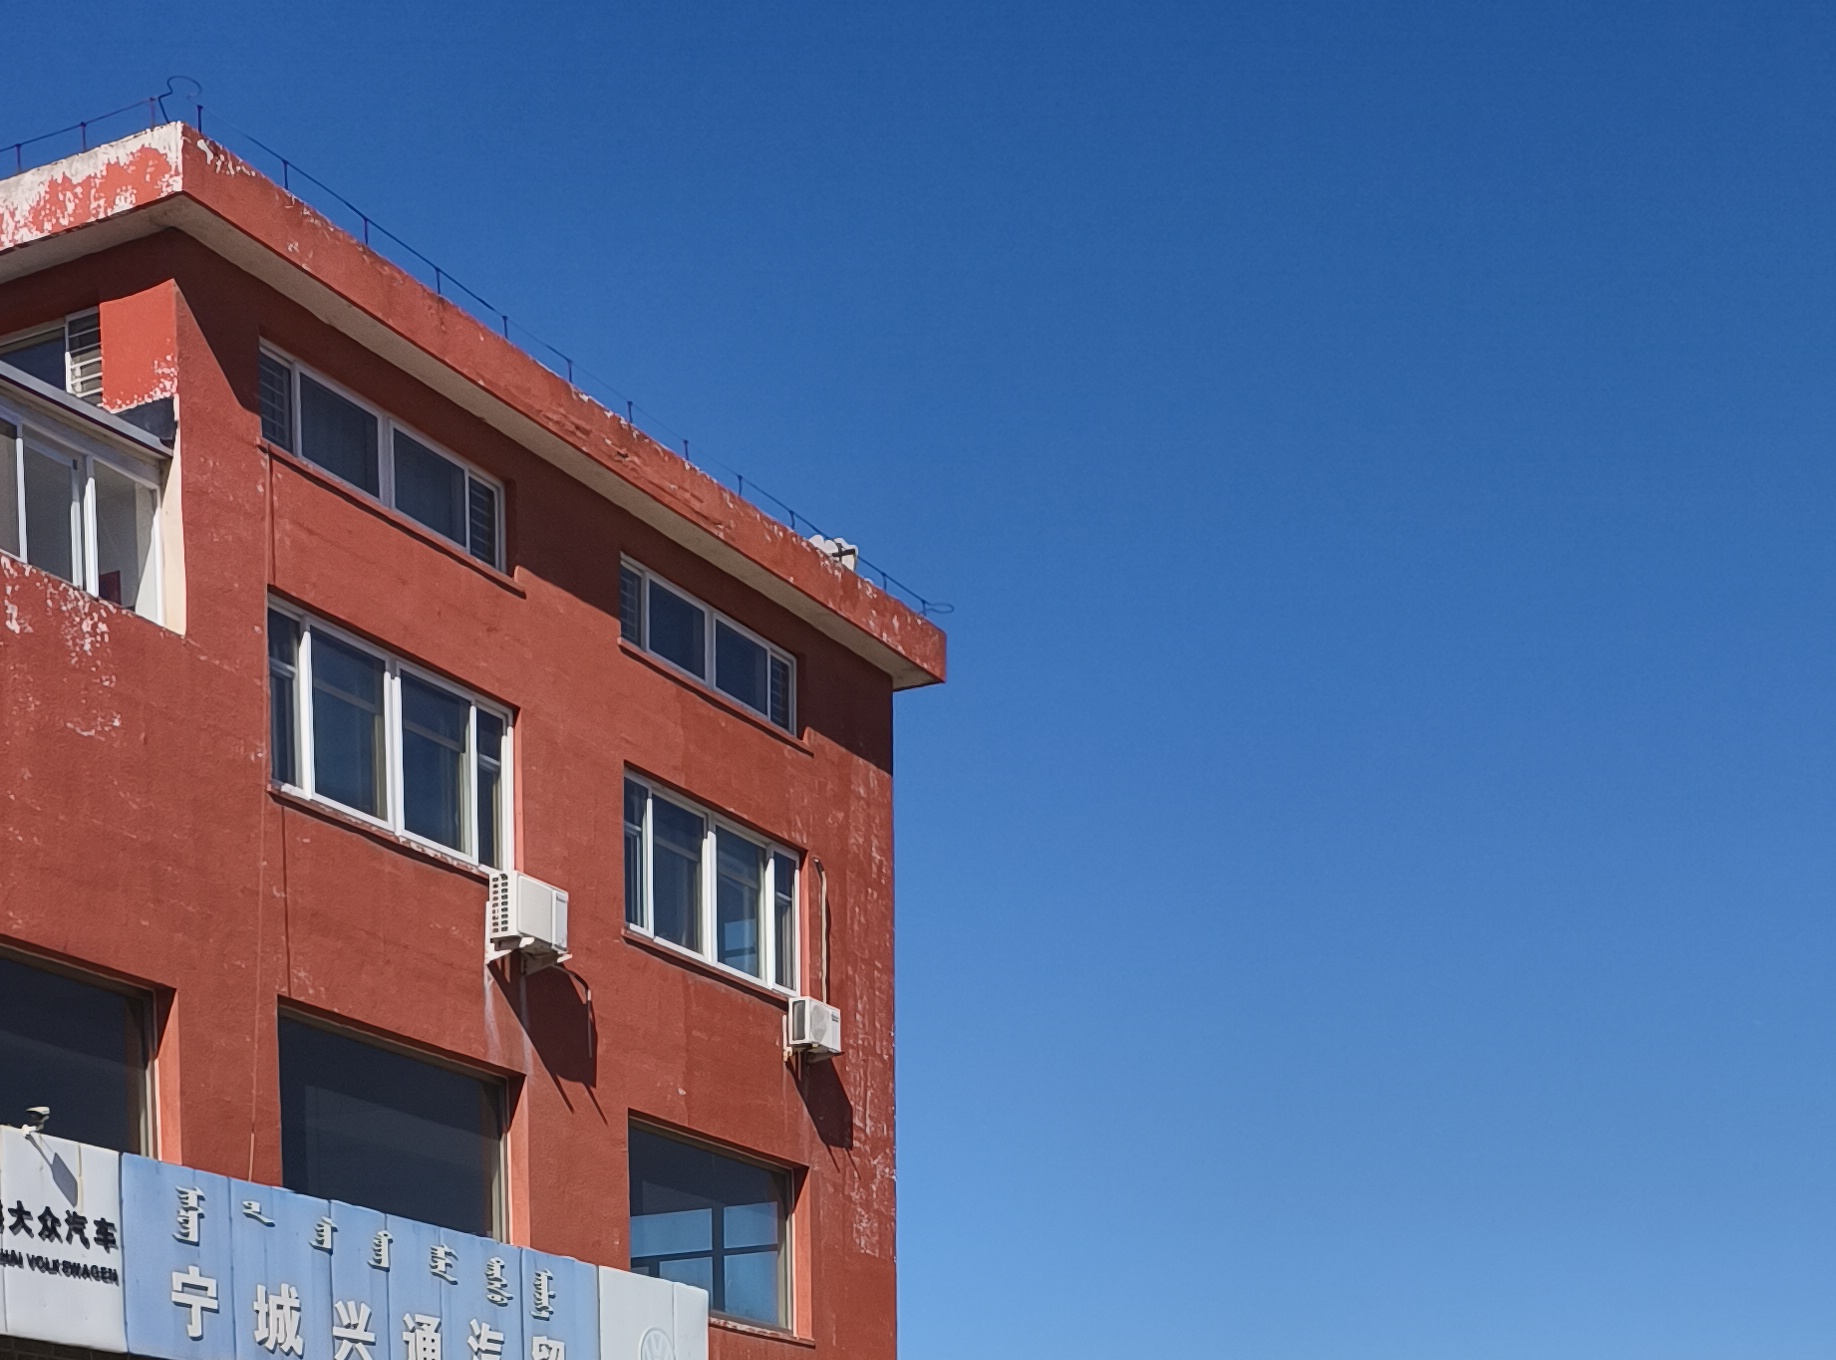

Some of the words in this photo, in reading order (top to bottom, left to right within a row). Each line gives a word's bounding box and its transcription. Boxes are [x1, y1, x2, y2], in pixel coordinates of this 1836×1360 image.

[0, 1199, 119, 1254] 大众汽车
[26, 1253, 119, 1287] VOLKSWAGEN
